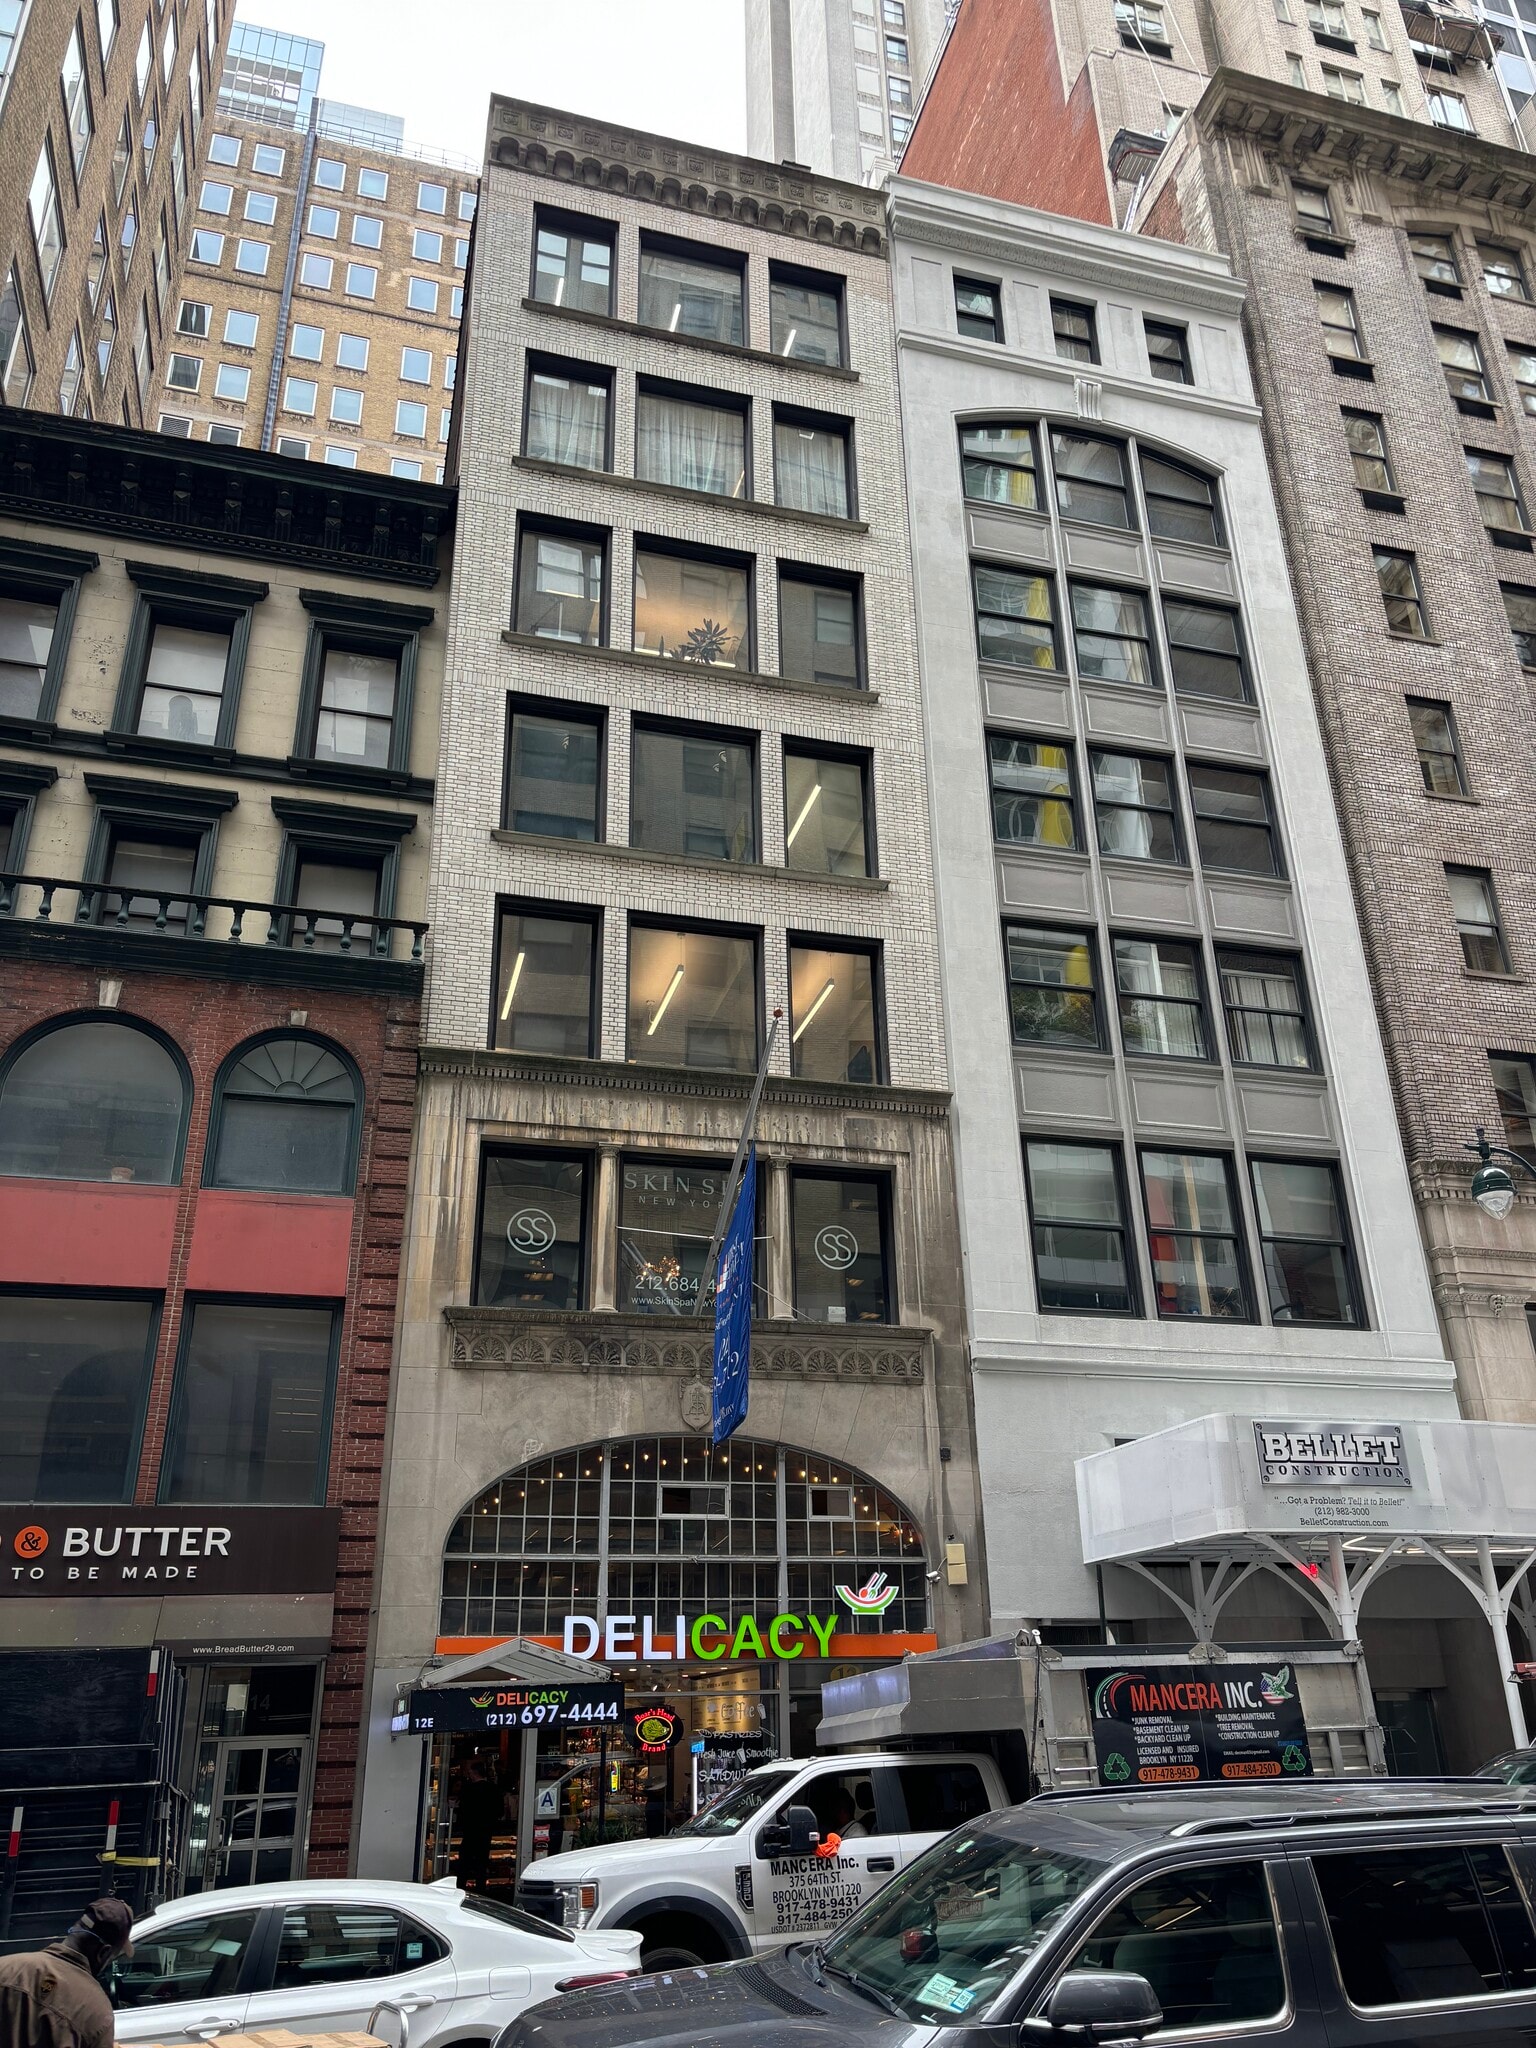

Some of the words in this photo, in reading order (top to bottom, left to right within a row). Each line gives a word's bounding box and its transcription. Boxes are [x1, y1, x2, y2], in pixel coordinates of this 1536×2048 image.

[624, 1172, 690, 1194] SKIN
[638, 1195, 676, 1206] NEW
[1260, 1432, 1401, 1465] BELLET
[1266, 1465, 1404, 1478] CONSTRUCTION
[1310, 1496, 1346, 1506] Problem?
[1349, 1497, 1362, 1506] Tell
[1363, 1497, 1369, 1505] it
[1370, 1498, 1377, 1506] to
[1314, 1507, 1334, 1517] (212)
[1335, 1507, 1370, 1516] 982-3000
[1300, 1518, 1389, 1527] BelletConstruction.com
[21, 1532, 42, 1552] &
[63, 1527, 232, 1557] BUTTER
[12, 1567, 44, 1580] TO
[67, 1567, 100, 1580] BE
[122, 1566, 198, 1579] MADE
[563, 1614, 839, 1661] DELICACY
[193, 1644, 295, 1654] www.BreadButter29.com
[496, 1690, 569, 1706] DELICACY
[1130, 1683, 1223, 1712] MANCERA
[1223, 1681, 1263, 1709] INC.
[415, 1717, 434, 1729] 12E
[486, 1713, 516, 1727] (212)
[520, 1702, 619, 1725] 697-4444
[634, 1708, 656, 1723] Boar's
[656, 1708, 676, 1722] Head
[1148, 1716, 1174, 1724] REMOVAL
[1241, 1712, 1276, 1721] MAINTENANCE
[1164, 1725, 1182, 1733] CLEAN
[1182, 1724, 1190, 1733] UP
[1231, 1722, 1255, 1731] REMOVAL
[1166, 1734, 1183, 1743] CLEAN
[1183, 1733, 1191, 1742] UP
[1257, 1731, 1273, 1739] CLEAN
[1273, 1730, 1280, 1738] UP
[642, 1743, 666, 1753] Brand
[717, 1748, 736, 1759] Juice
[746, 1747, 779, 1759] Smoothie
[1137, 1746, 1161, 1755] LICENSED
[1162, 1746, 1174, 1754] AND
[1177, 1744, 1200, 1753] INSURED
[1139, 1755, 1167, 1765] BROOKLYN
[1169, 1755, 1177, 1763] NY
[1178, 1754, 1194, 1763] 11220
[1143, 1766, 1196, 1780] 917-478-9431
[1227, 1763, 1278, 1776] 917-484-2501
[541, 1791, 554, 1807] A
[770, 1857, 834, 1876] MANCERA
[836, 1855, 859, 1870] Inc.
[789, 1875, 805, 1888] 375
[807, 1873, 829, 1886] 64Th
[831, 1871, 844, 1883] ST.
[772, 1887, 821, 1904] BROOKLYN
[777, 1895, 860, 1914] 917-478-9431
[777, 1908, 854, 1925] 917-484-250
[771, 1925, 791, 1934] USDOT
[796, 1922, 820, 1932] 2372811
[824, 1921, 838, 1930] GVW
